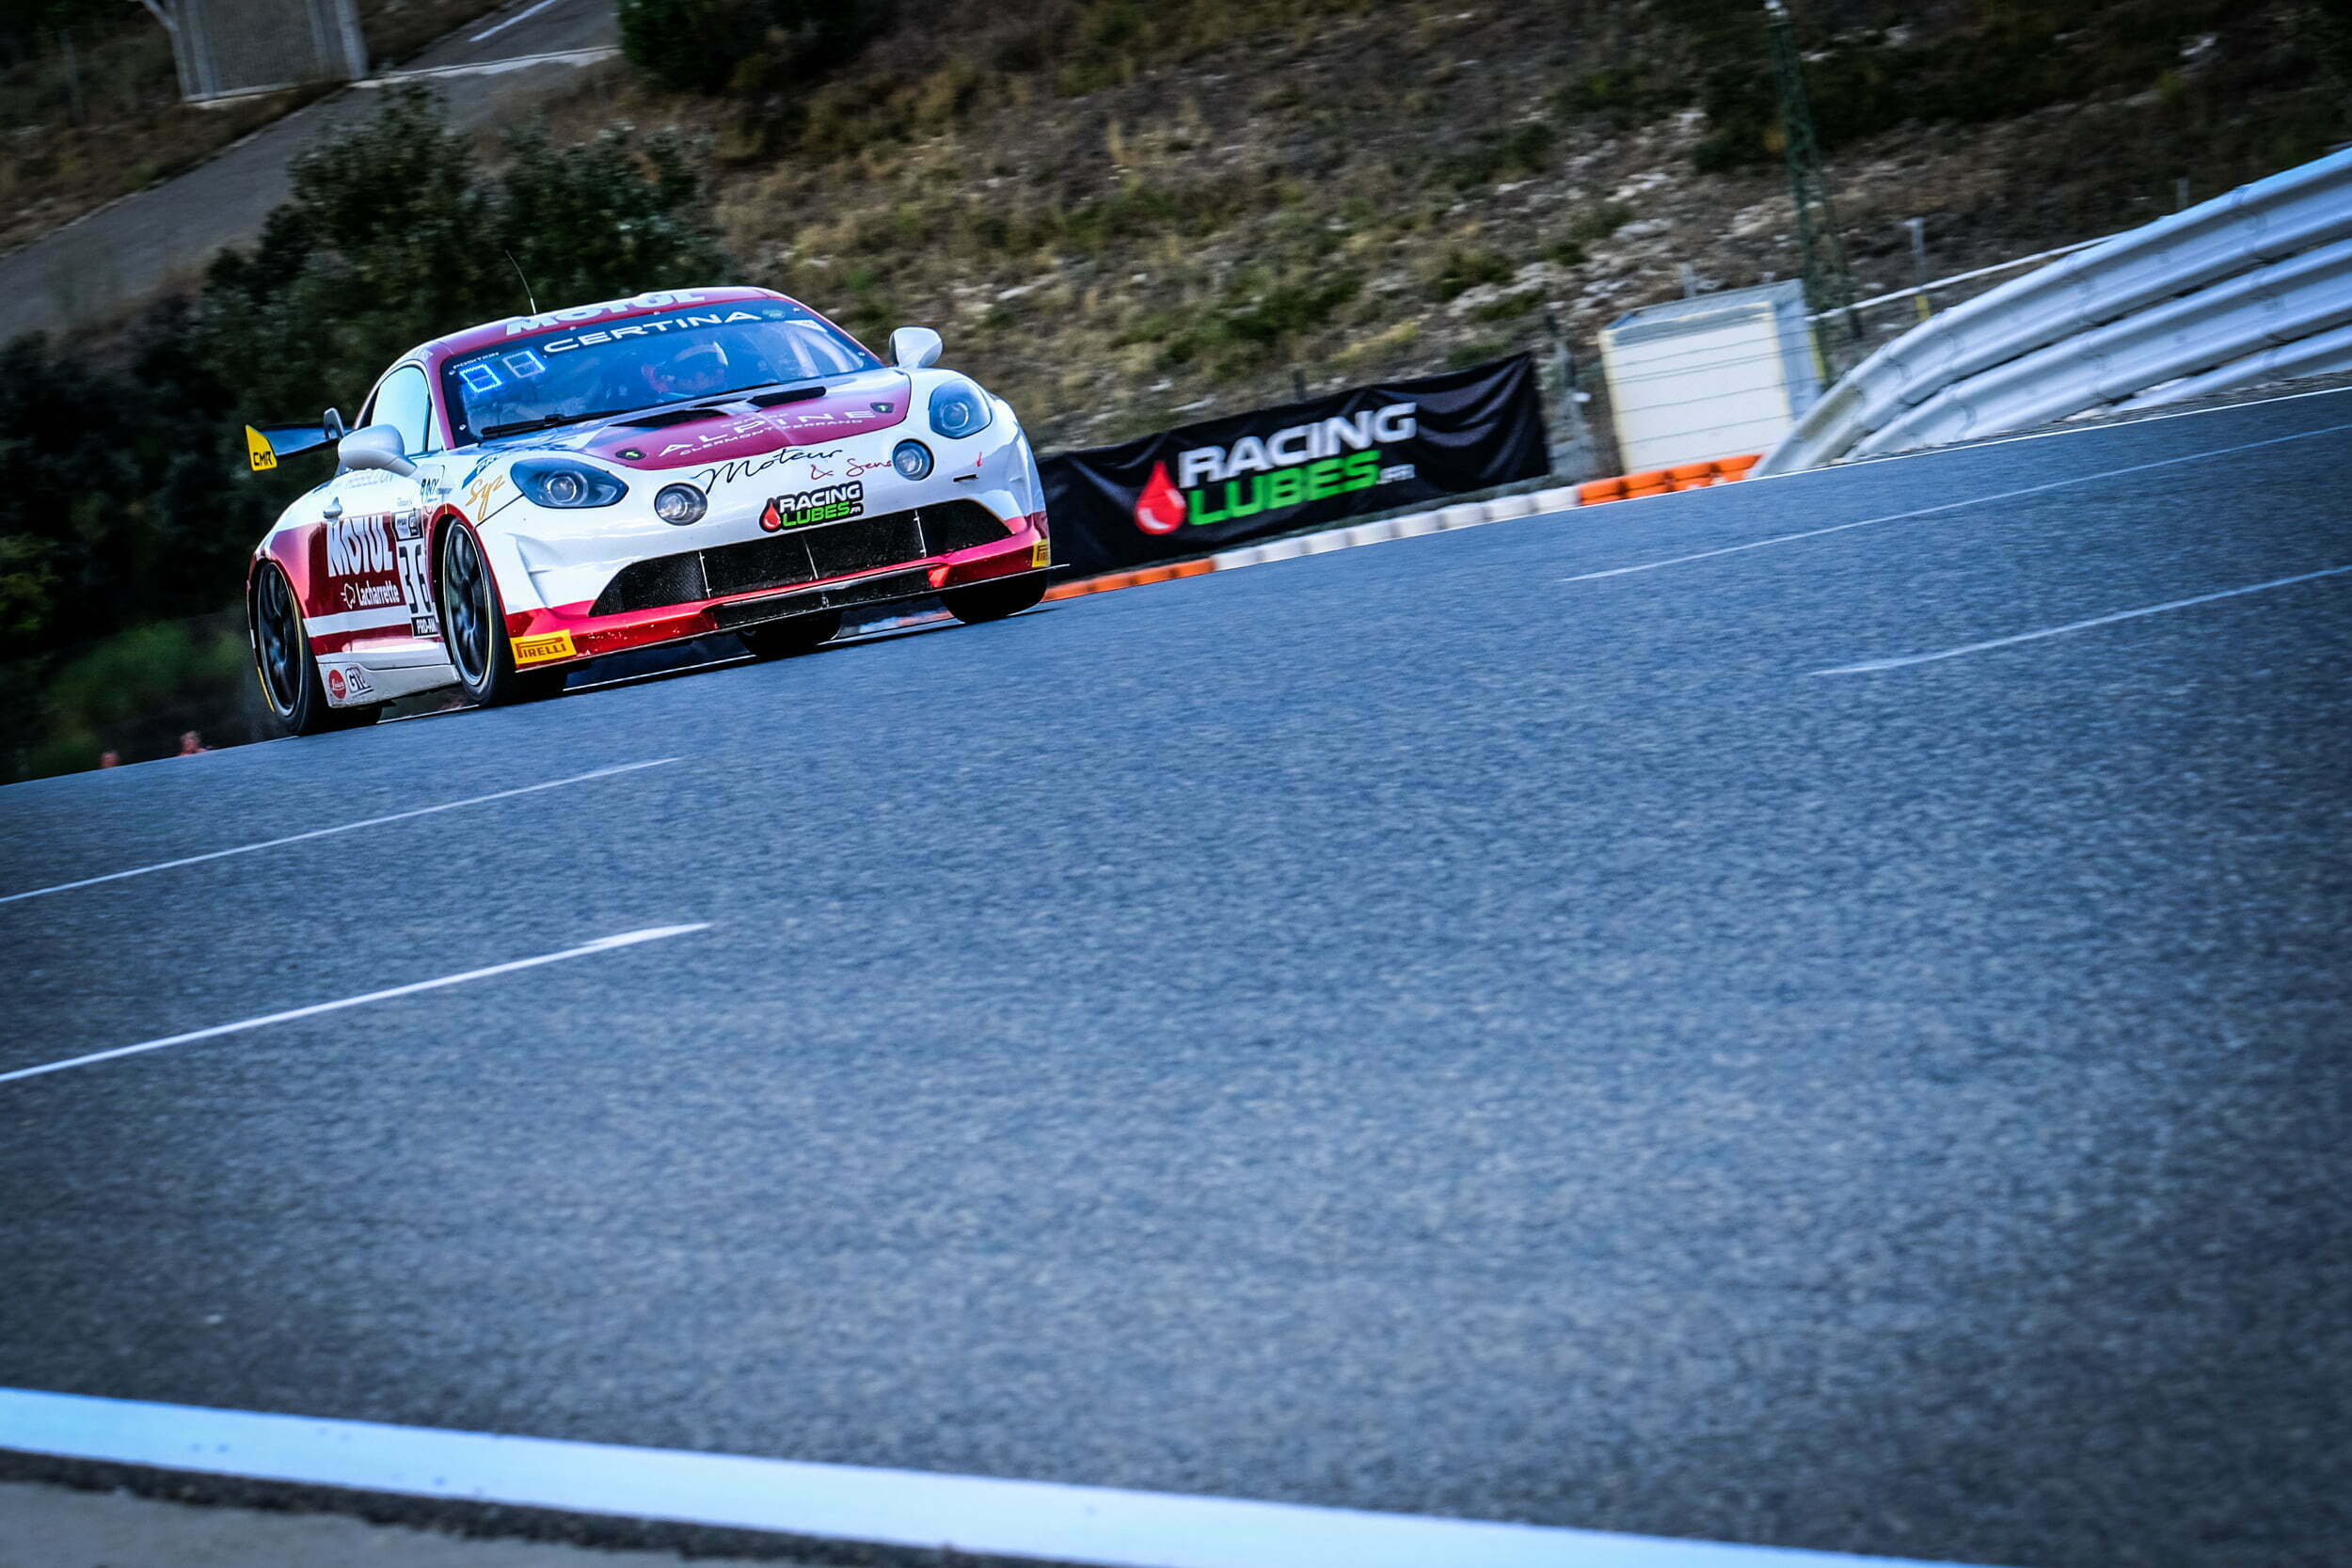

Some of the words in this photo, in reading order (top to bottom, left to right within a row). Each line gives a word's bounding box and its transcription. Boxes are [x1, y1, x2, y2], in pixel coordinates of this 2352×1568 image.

[506, 292, 707, 336] MOTUL
[544, 311, 762, 353] CERTINA
[659, 410, 876, 457] ALPINE
[1178, 403, 1417, 489] RACING
[253, 451, 273, 467] CMR
[691, 448, 844, 495] Moteur
[780, 483, 861, 514] RACING
[326, 514, 393, 578] MOTUL
[515, 637, 567, 659] PIRELLI
